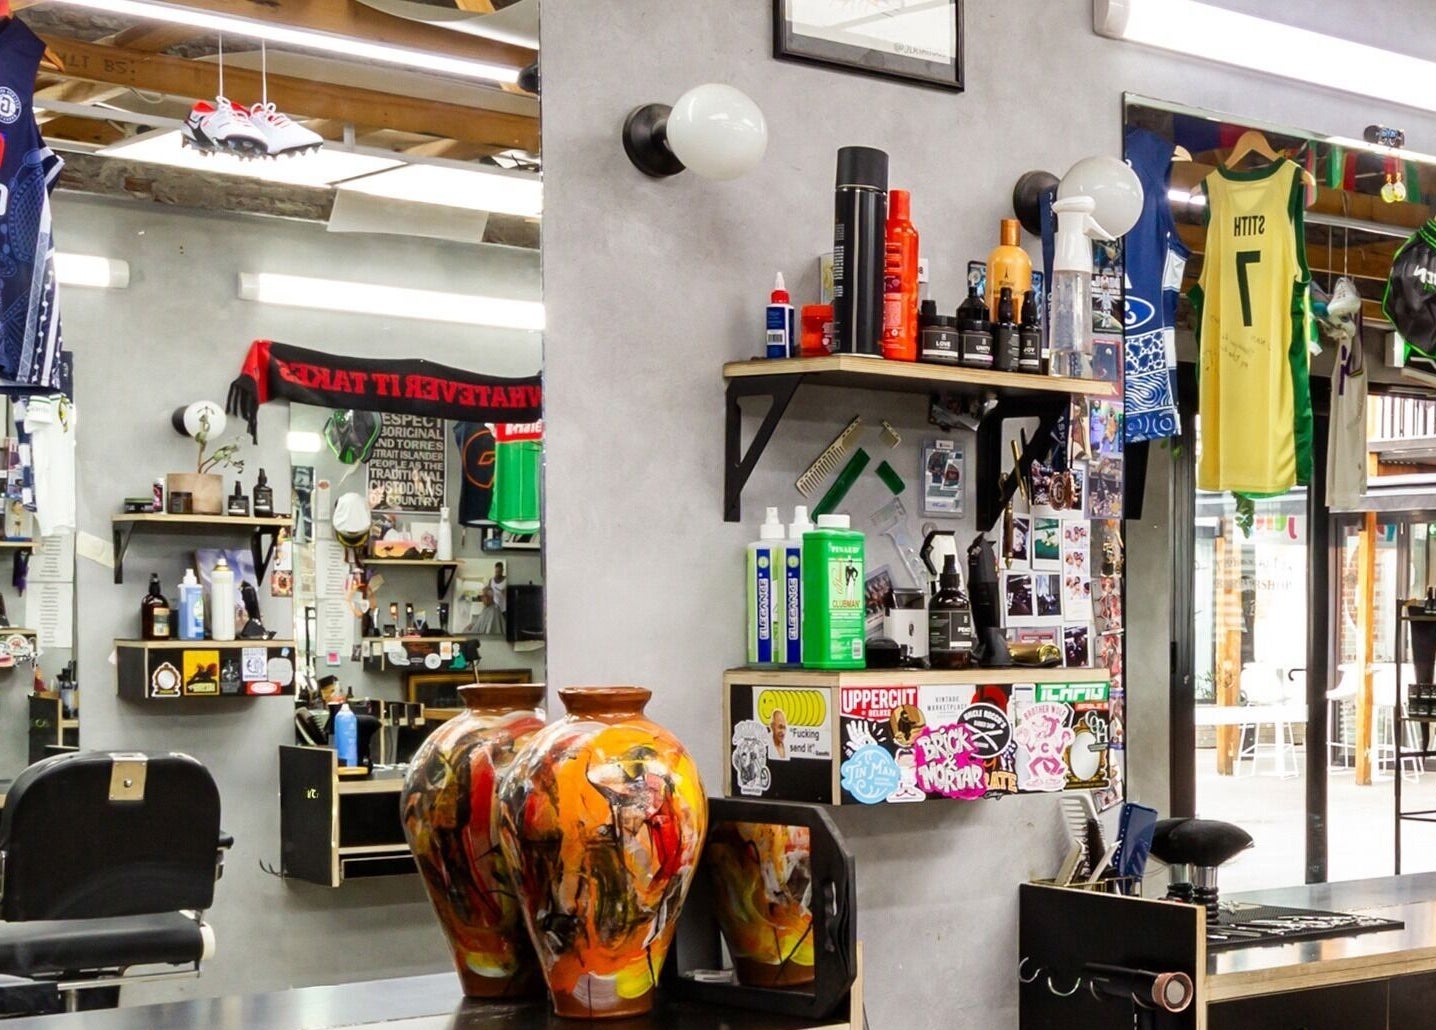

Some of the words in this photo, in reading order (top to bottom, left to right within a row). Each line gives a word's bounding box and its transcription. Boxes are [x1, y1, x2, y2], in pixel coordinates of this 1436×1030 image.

[382, 413, 443, 428] ESPECT
[381, 426, 443, 440] BORIGINAL
[396, 440, 443, 450] TORRES
[401, 450, 443, 461] ISLANDER
[369, 459, 405, 469] PEOPLE
[407, 461, 422, 470] AS
[423, 462, 443, 471] THE
[370, 468, 443, 482] TRADITIONAL
[369, 480, 443, 496] CUSTODIANS
[370, 493, 384, 505] OF
[759, 578, 769, 640] ELEGANCE
[842, 688, 917, 712] UPPERCUT
